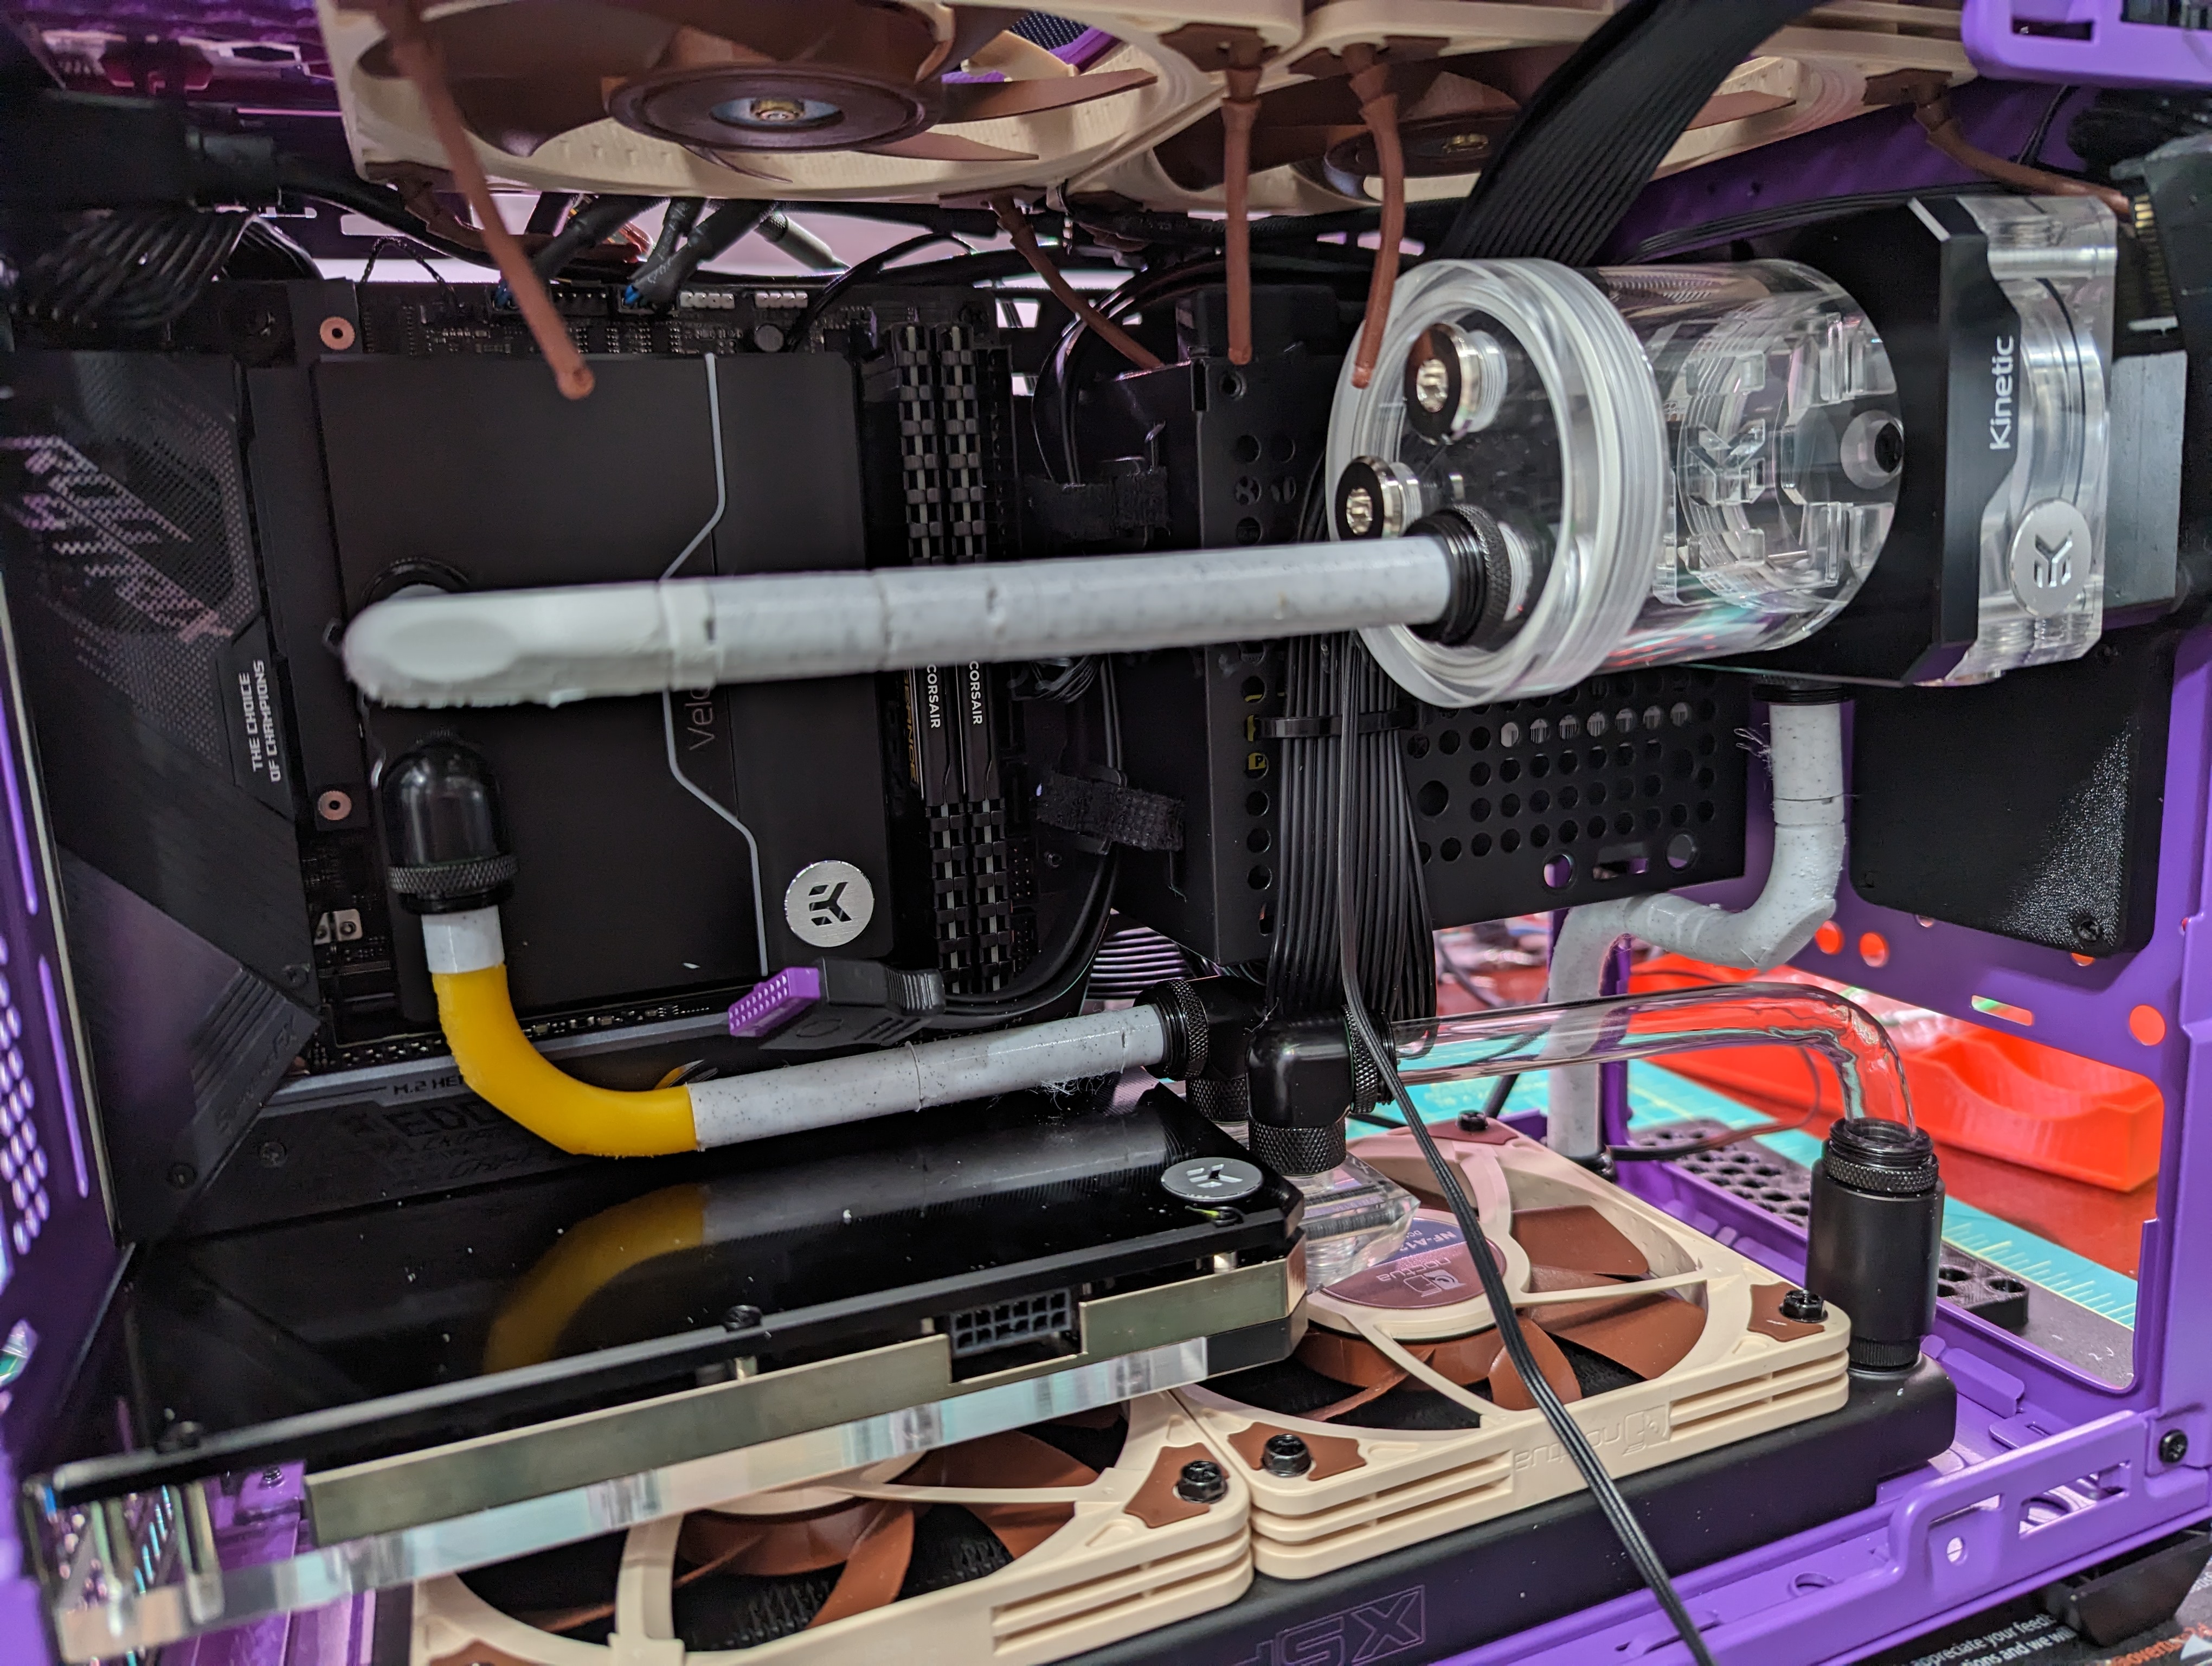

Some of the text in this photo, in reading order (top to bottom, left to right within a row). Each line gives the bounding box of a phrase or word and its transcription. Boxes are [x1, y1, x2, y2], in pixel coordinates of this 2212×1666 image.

[1988, 335, 2015, 451] Kinetic
[253, 659, 282, 783] OF CHAMPIONS
[926, 663, 941, 729] CORSAIR
[968, 660, 984, 725] CORSAIR
[238, 672, 264, 773] THE CHOICE
[393, 1080, 427, 1095] M.2
[1375, 1256, 1452, 1283] noctua
[1514, 1422, 1621, 1471] notua
[1982, 1623, 2017, 1648] your
[2001, 1640, 2030, 1660] and
